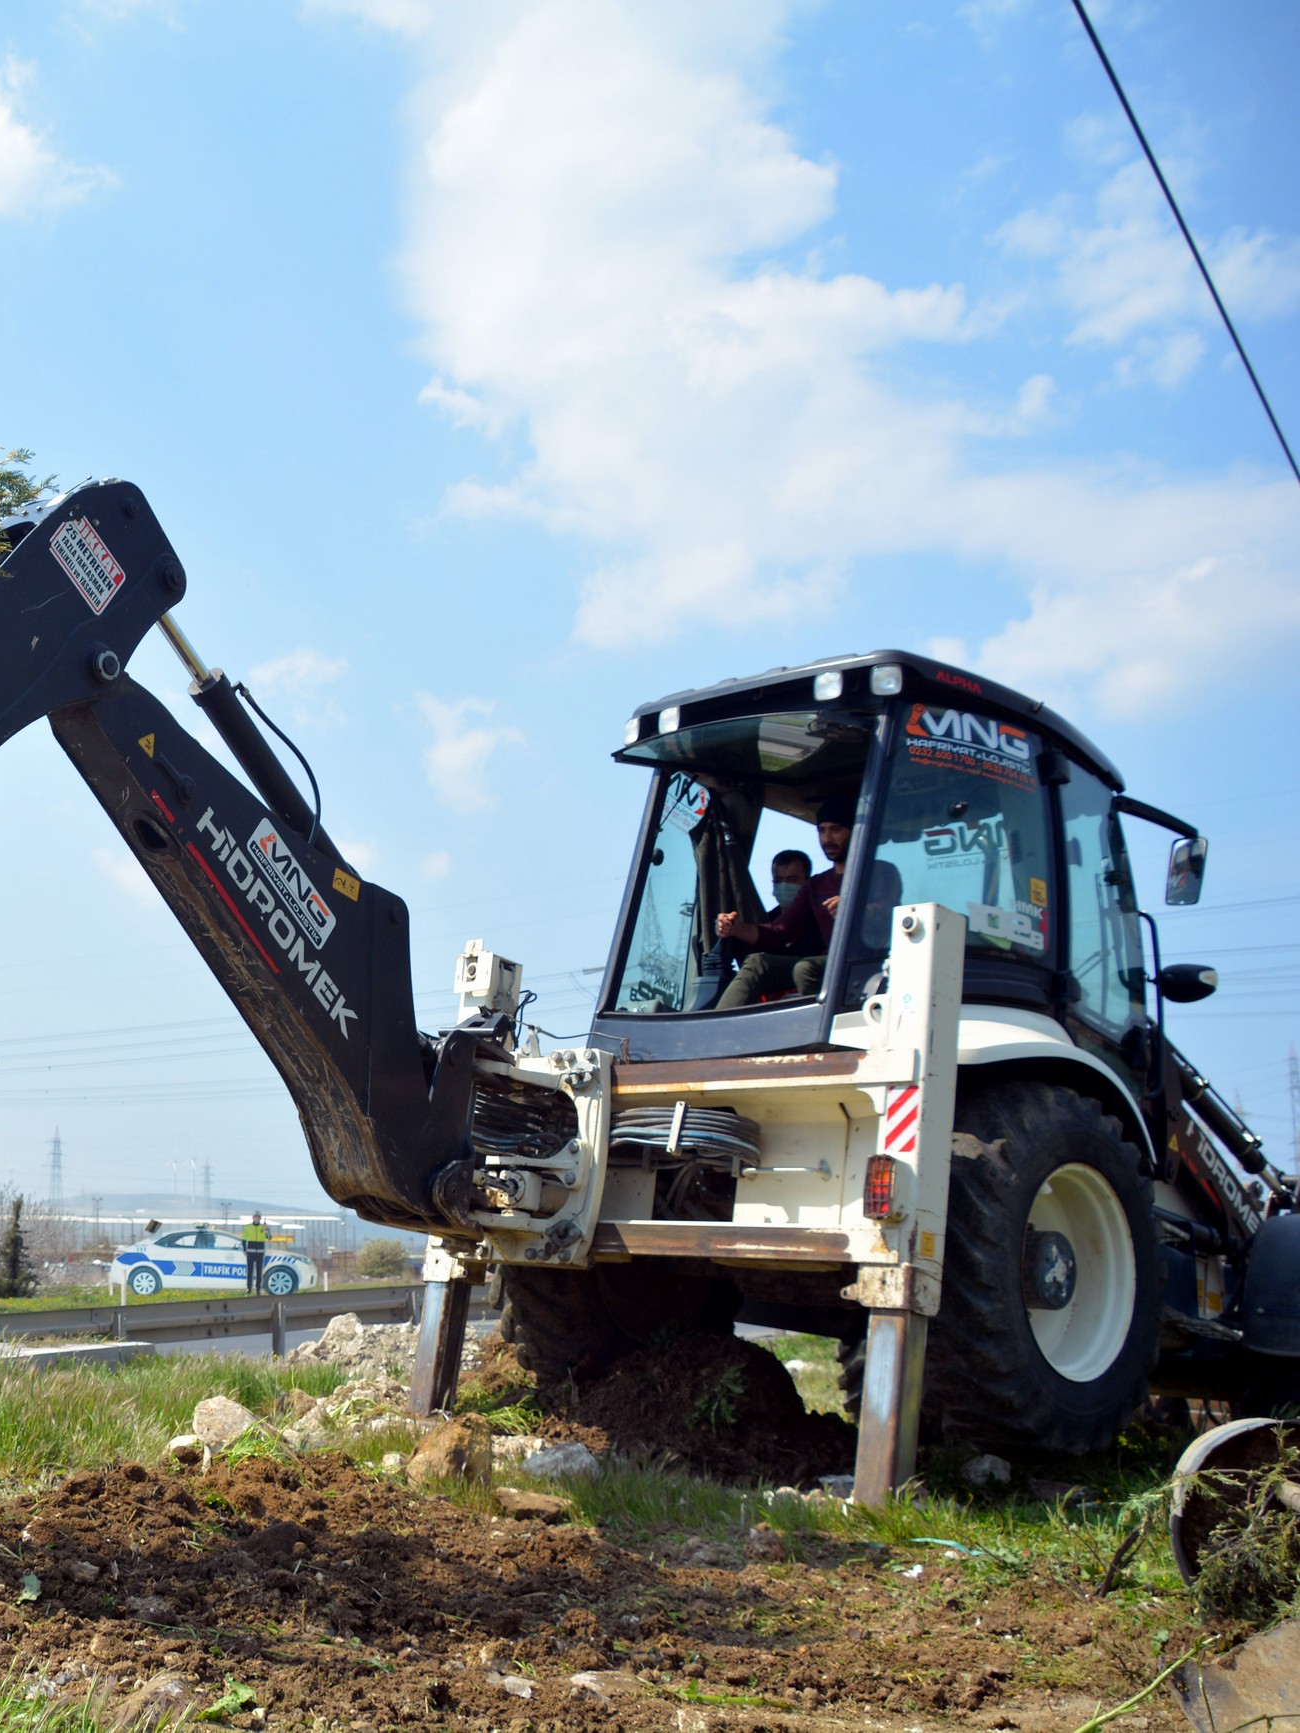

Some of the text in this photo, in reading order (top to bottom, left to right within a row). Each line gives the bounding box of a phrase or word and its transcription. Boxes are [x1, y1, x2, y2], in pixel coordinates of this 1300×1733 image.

[53, 540, 102, 608] TEHLİKELİ ve YASAKTIR
[61, 535, 105, 596] FAZLA YAKLAŞMAK
[65, 523, 114, 591] 25 METREDEN
[936, 671, 982, 694] ALPHA
[1010, 900, 1044, 920] HMK
[204, 1265, 247, 1276] TRAFİK POL
